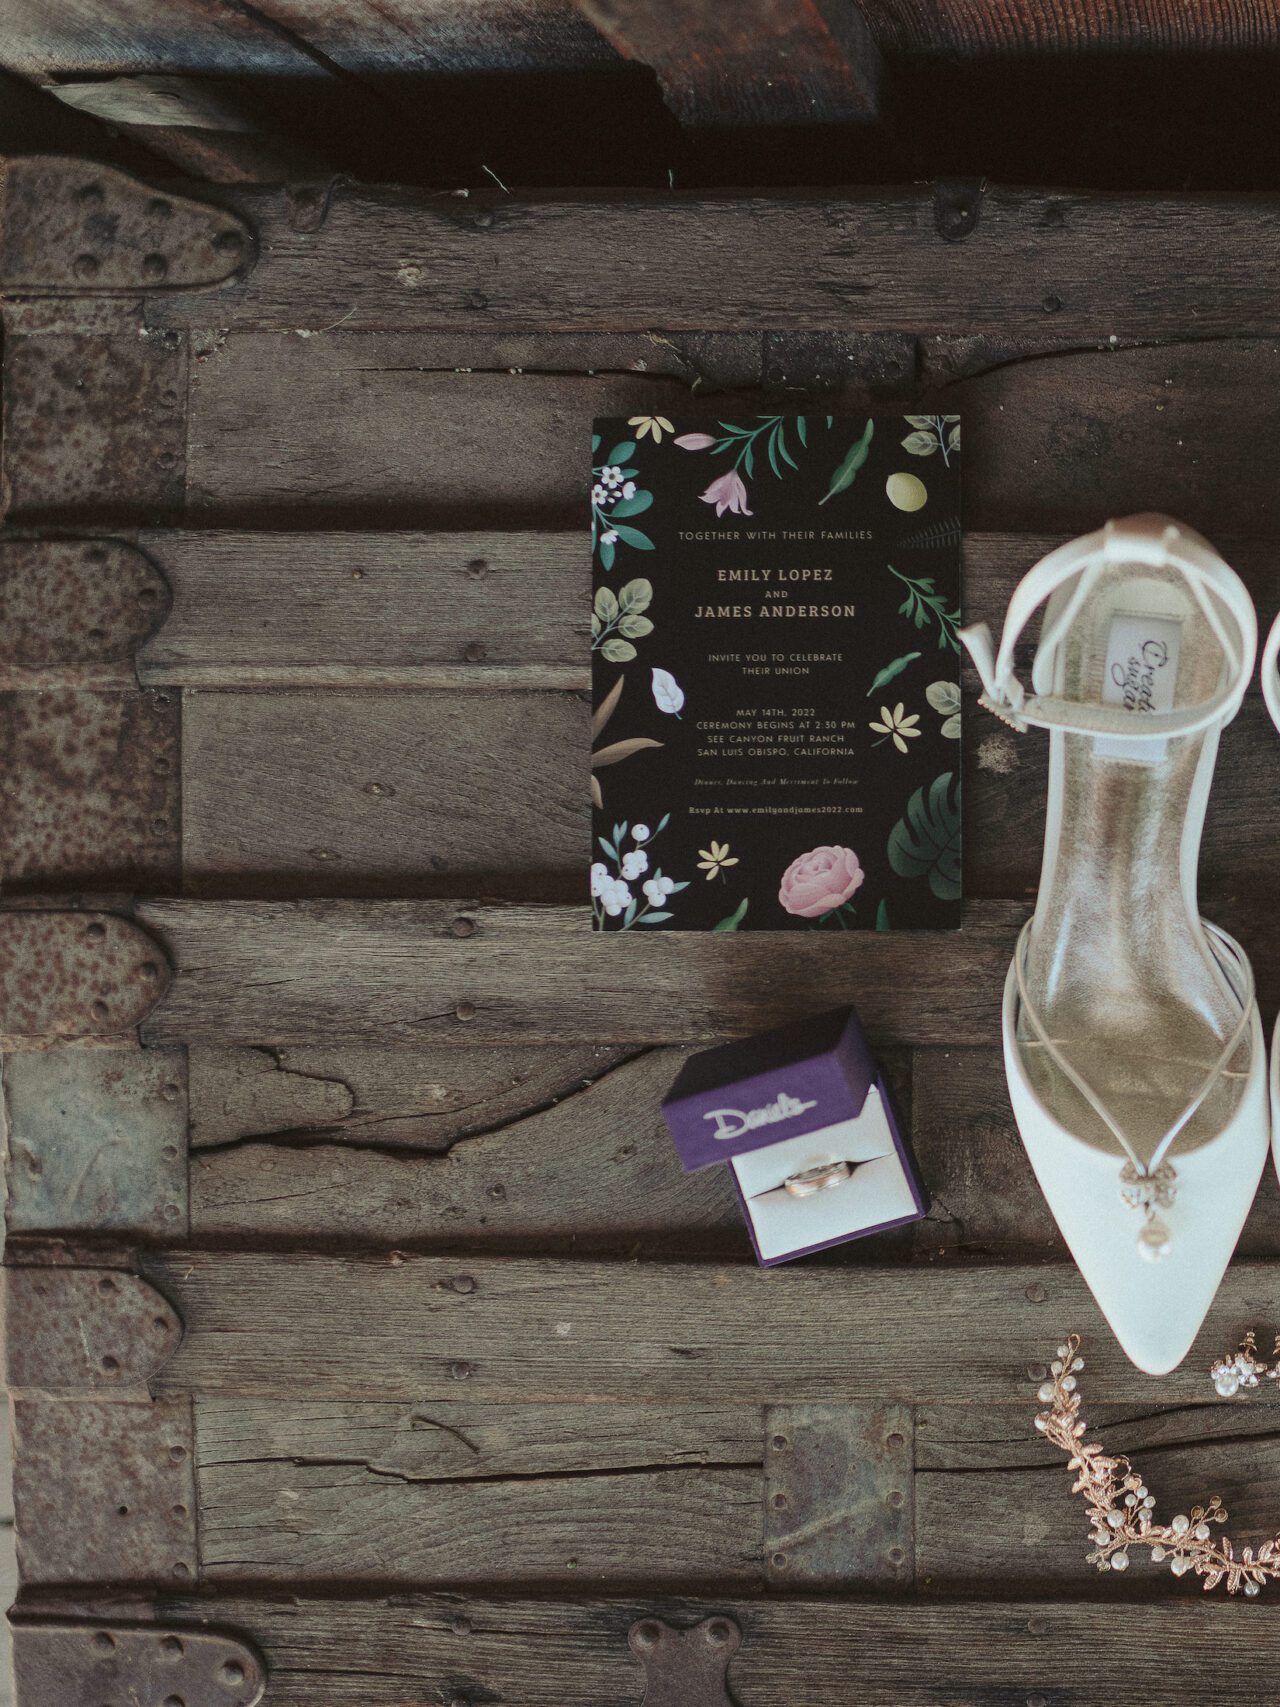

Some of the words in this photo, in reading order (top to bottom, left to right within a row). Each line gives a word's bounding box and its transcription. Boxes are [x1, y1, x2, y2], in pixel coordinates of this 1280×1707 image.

[678, 531, 740, 541] TOGETHER
[746, 531, 776, 540] WITH
[782, 531, 815, 540] THEIR
[821, 530, 873, 540] FAMILIES
[717, 569, 771, 581] EMILY
[778, 569, 833, 581] LOPEZ
[765, 590, 788, 598] AND
[695, 606, 752, 618] JAMES
[759, 605, 855, 617] ANDERSON
[708, 653, 741, 662] INVITE
[745, 653, 767, 662] YOU
[771, 653, 785, 662] TO
[789, 653, 843, 662] CELEBRATE
[742, 666, 770, 675] THEIR
[775, 666, 810, 675] UNION
[736, 709, 757, 717] MAY
[791, 708, 815, 717] 2022
[696, 721, 752, 730] CEREMONY
[757, 721, 795, 729] BEGINS
[799, 721, 811, 729] AT
[815, 721, 837, 729] 2:30
[841, 720, 855, 729] PM
[707, 735, 724, 743] SEE
[729, 735, 773, 743] CANYON
[778, 735, 804, 743] FRUIT
[809, 734, 844, 743] RANCH
[697, 748, 718, 756] SAN
[722, 748, 743, 756] LUIS
[794, 748, 855, 756] CALIFORNIA
[688, 806, 711, 815] Rsvp
[714, 806, 724, 814] At
